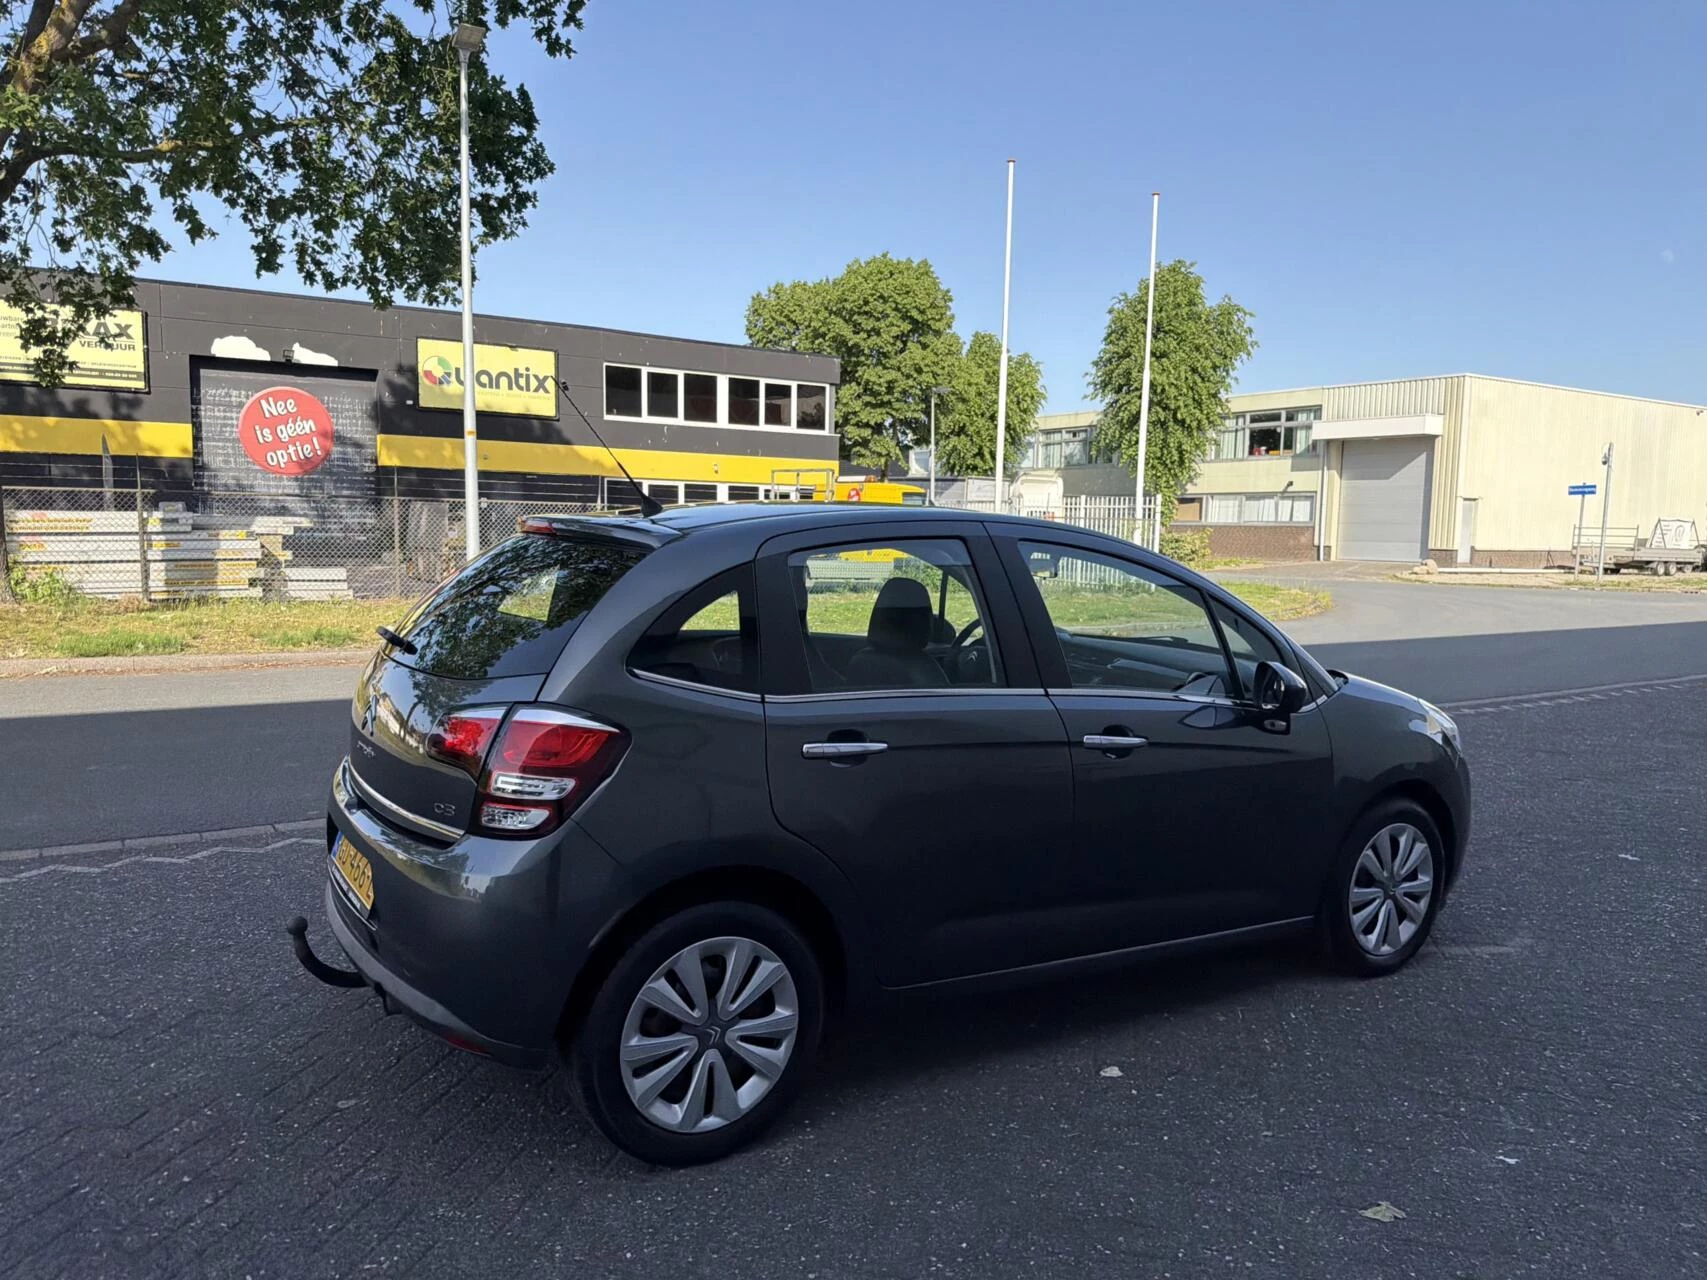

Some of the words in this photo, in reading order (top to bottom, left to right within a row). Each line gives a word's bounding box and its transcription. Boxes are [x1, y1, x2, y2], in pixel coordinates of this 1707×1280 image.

[80, 340, 136, 351] VERUUR
[260, 396, 297, 418] Nee
[254, 425, 273, 444] is
[276, 416, 316, 442] géén
[434, 802, 456, 816] C3
